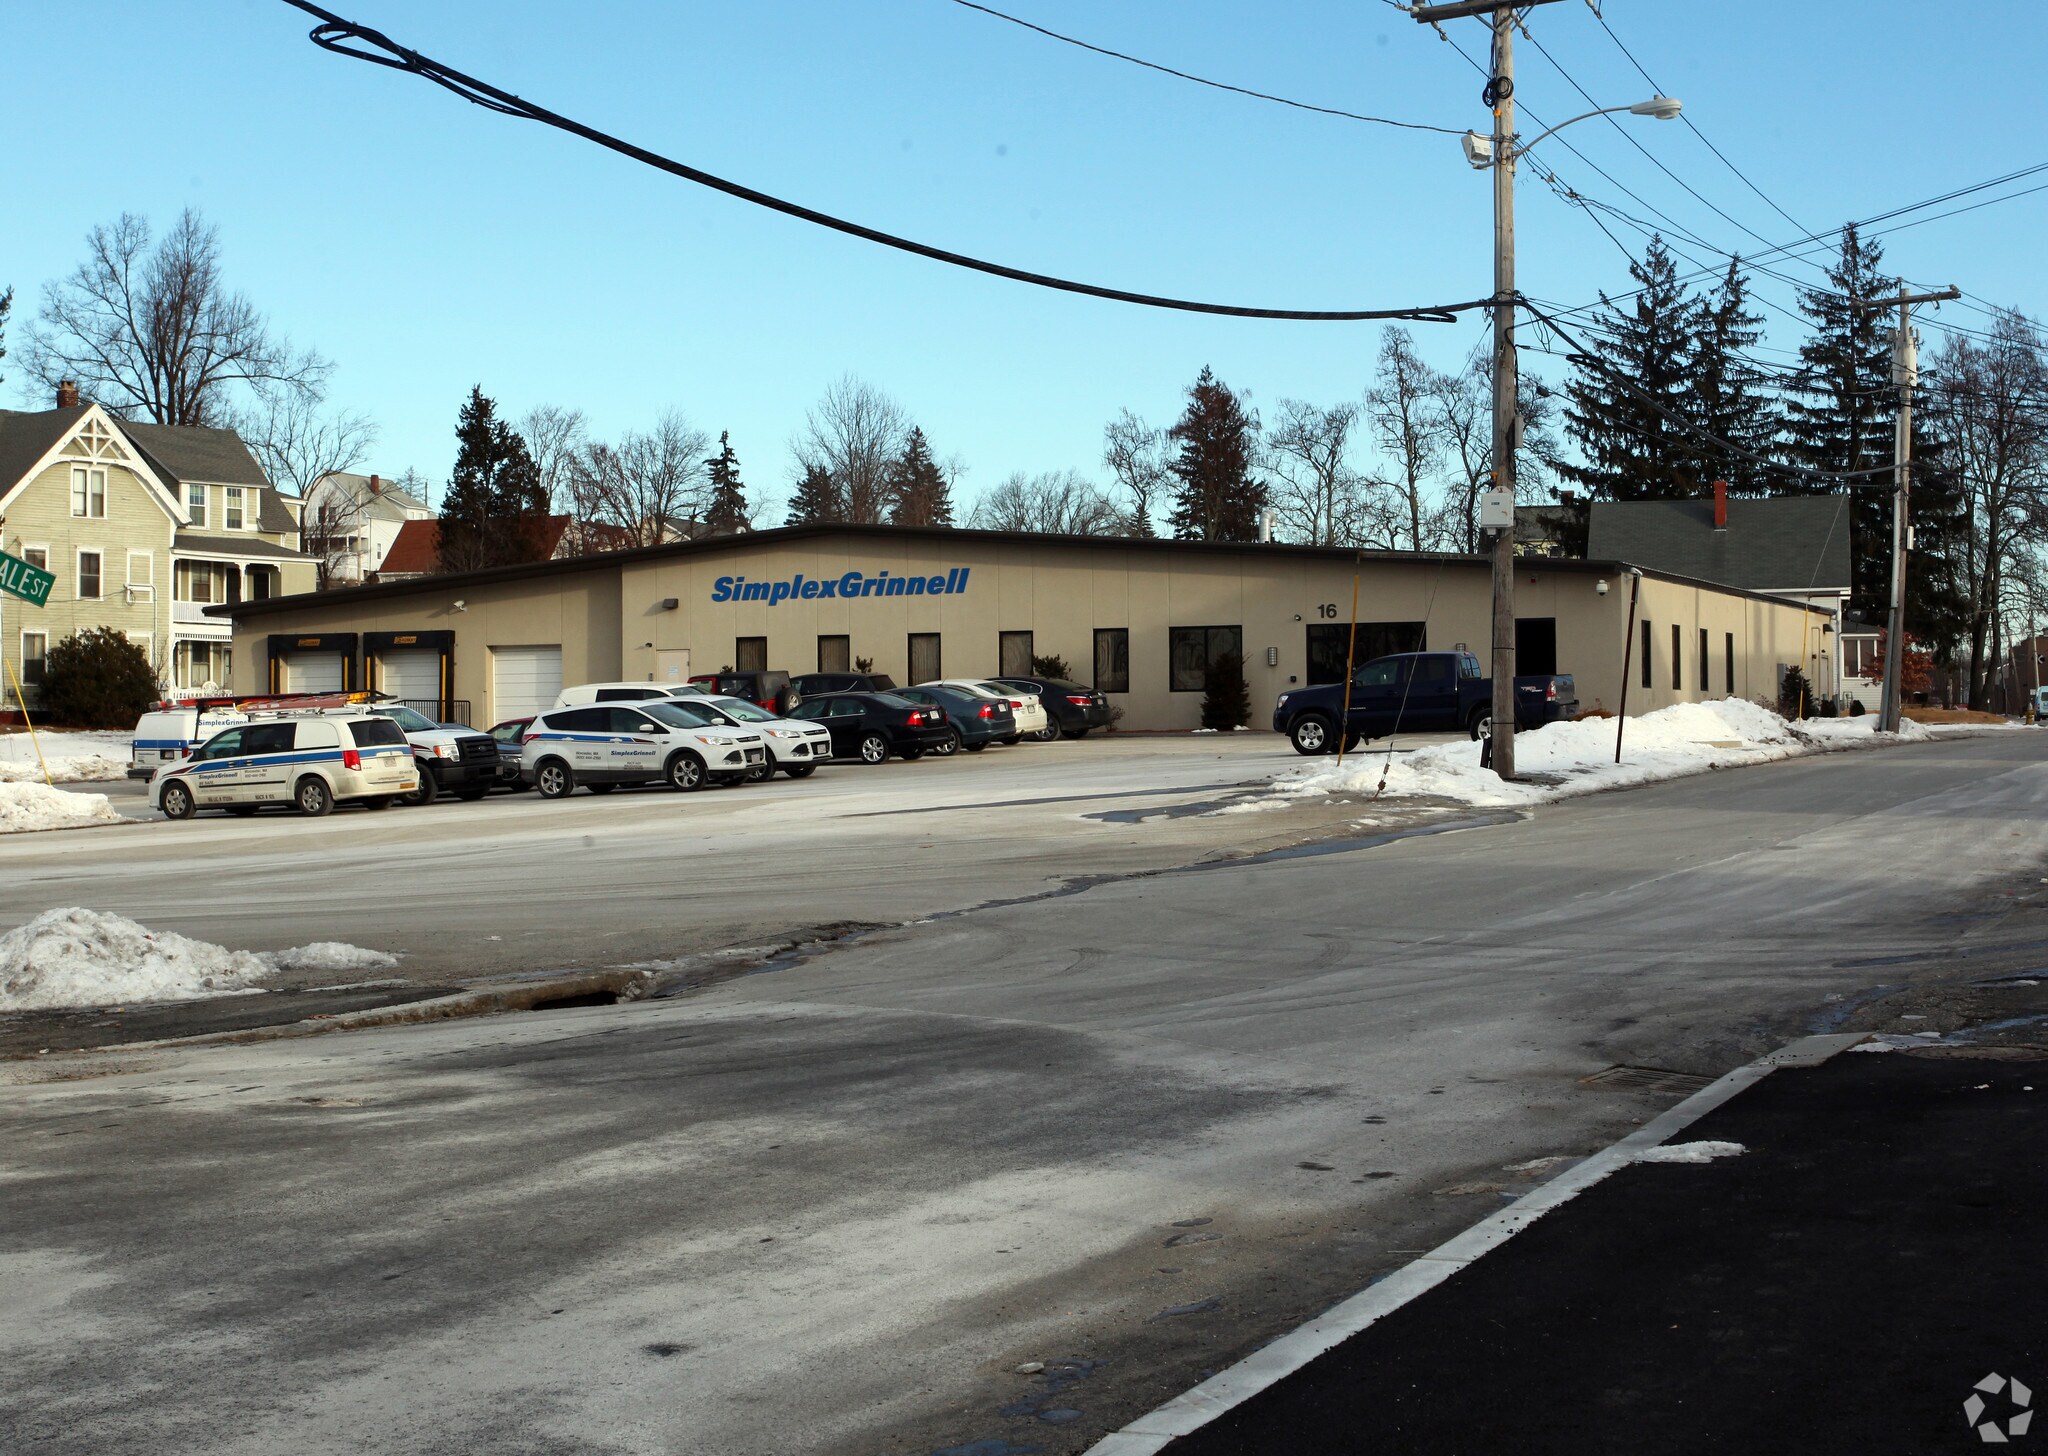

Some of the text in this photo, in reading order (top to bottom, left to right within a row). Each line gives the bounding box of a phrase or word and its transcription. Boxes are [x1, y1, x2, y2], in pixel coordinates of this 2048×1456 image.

[30, 578, 48, 597] ST
[711, 567, 970, 606] SimplexGrinnell
[1317, 604, 1337, 618] 16
